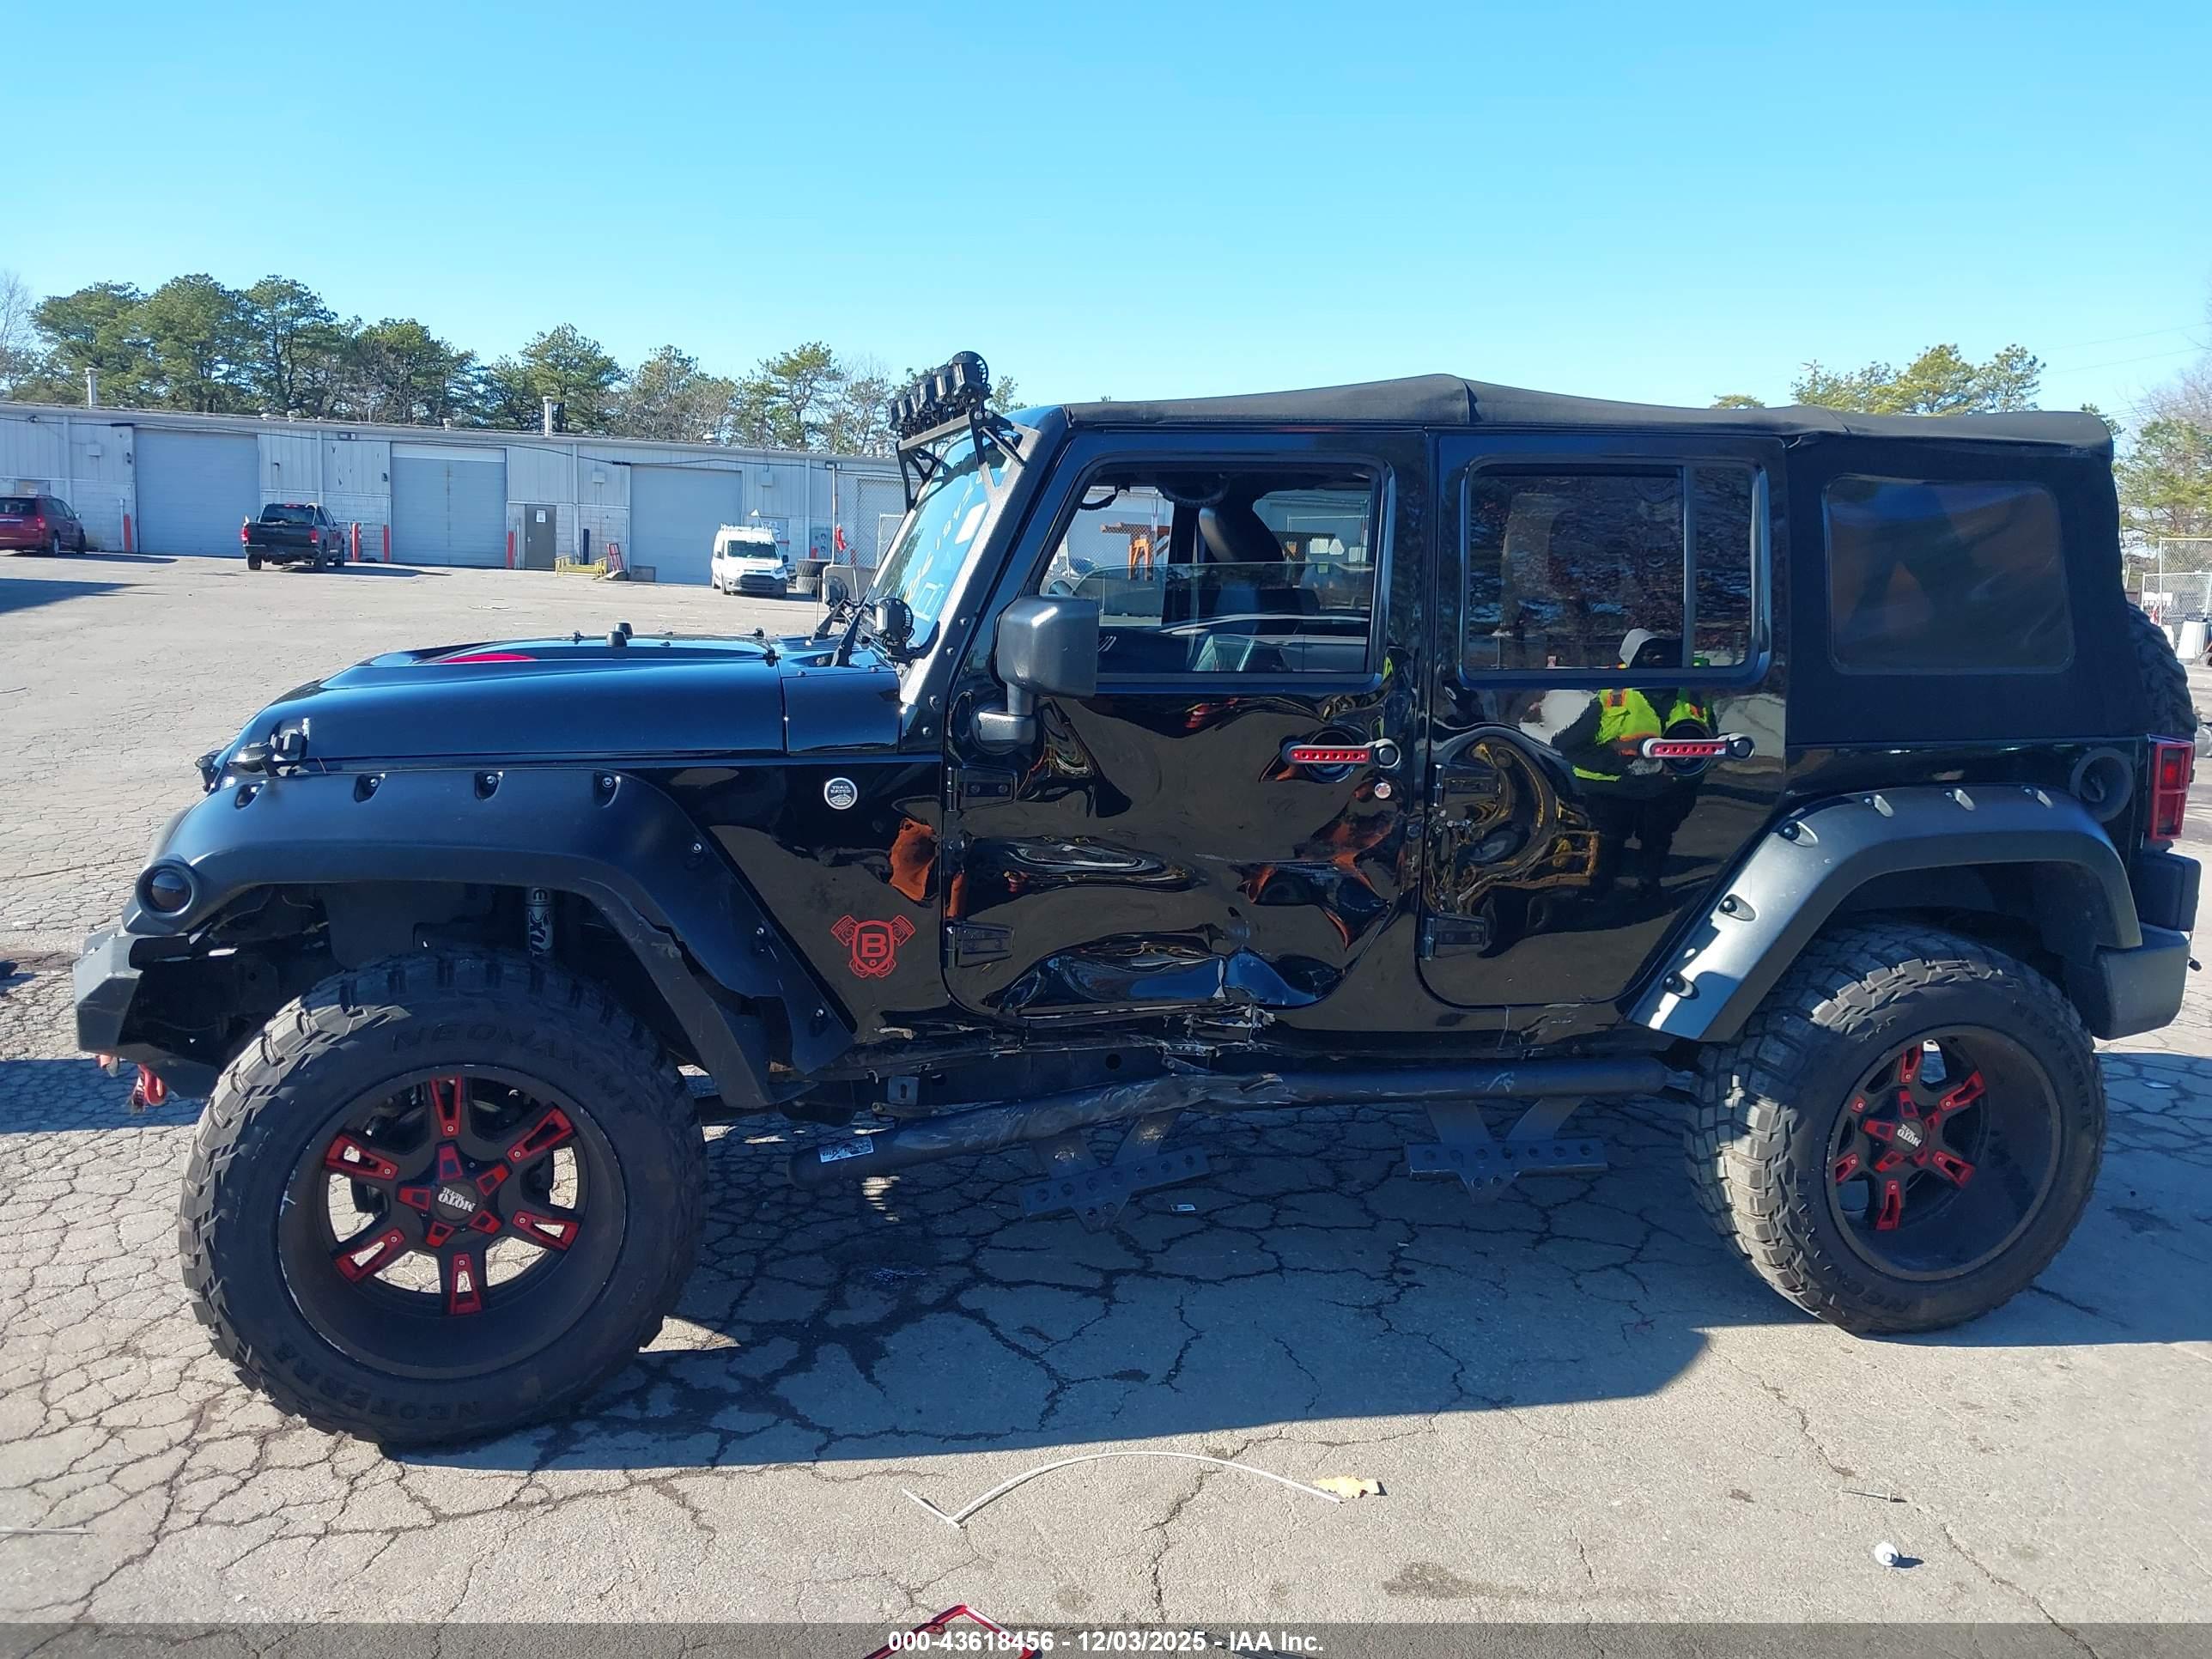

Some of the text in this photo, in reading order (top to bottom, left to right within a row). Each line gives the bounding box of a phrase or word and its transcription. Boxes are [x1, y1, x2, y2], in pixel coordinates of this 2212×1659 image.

[861, 933, 888, 957] B
[1897, 1128, 1922, 1148] MOTO
[437, 1193, 477, 1213] MOTO
